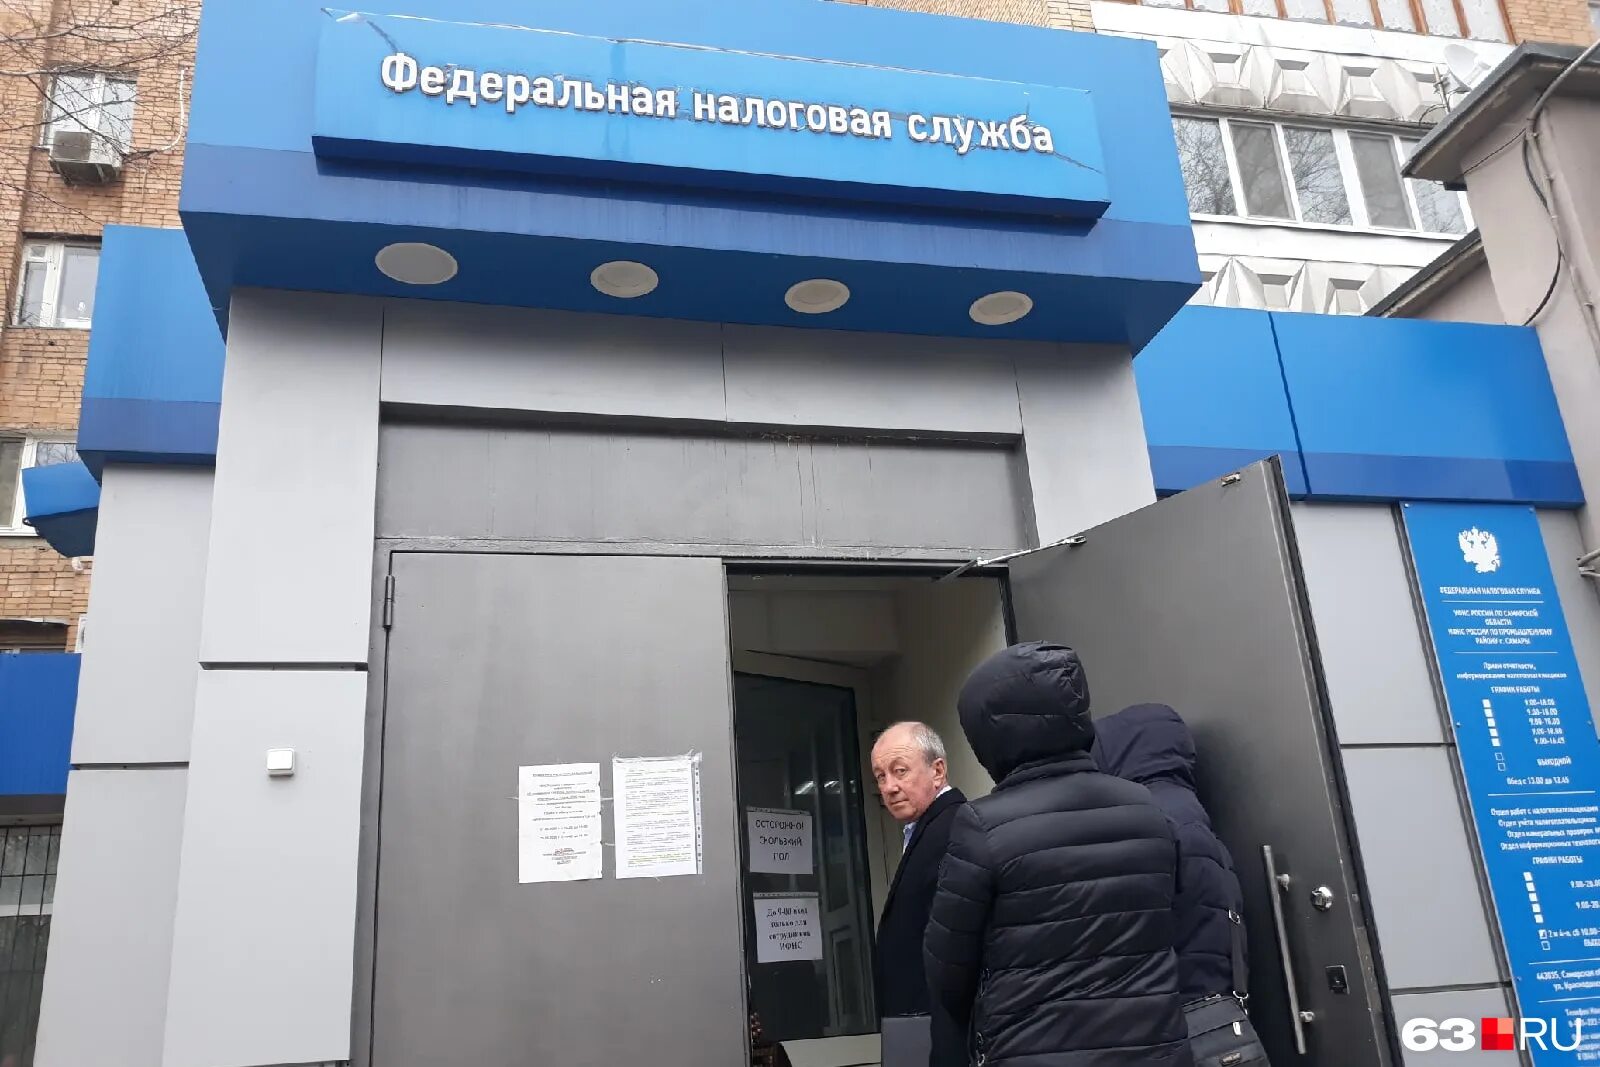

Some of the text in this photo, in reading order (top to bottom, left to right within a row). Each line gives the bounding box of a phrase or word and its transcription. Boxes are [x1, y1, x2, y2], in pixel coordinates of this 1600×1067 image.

[381, 52, 1054, 155] Федеральная налоговая служба
[759, 835, 803, 847] СКОЛЬЗКИЙ
